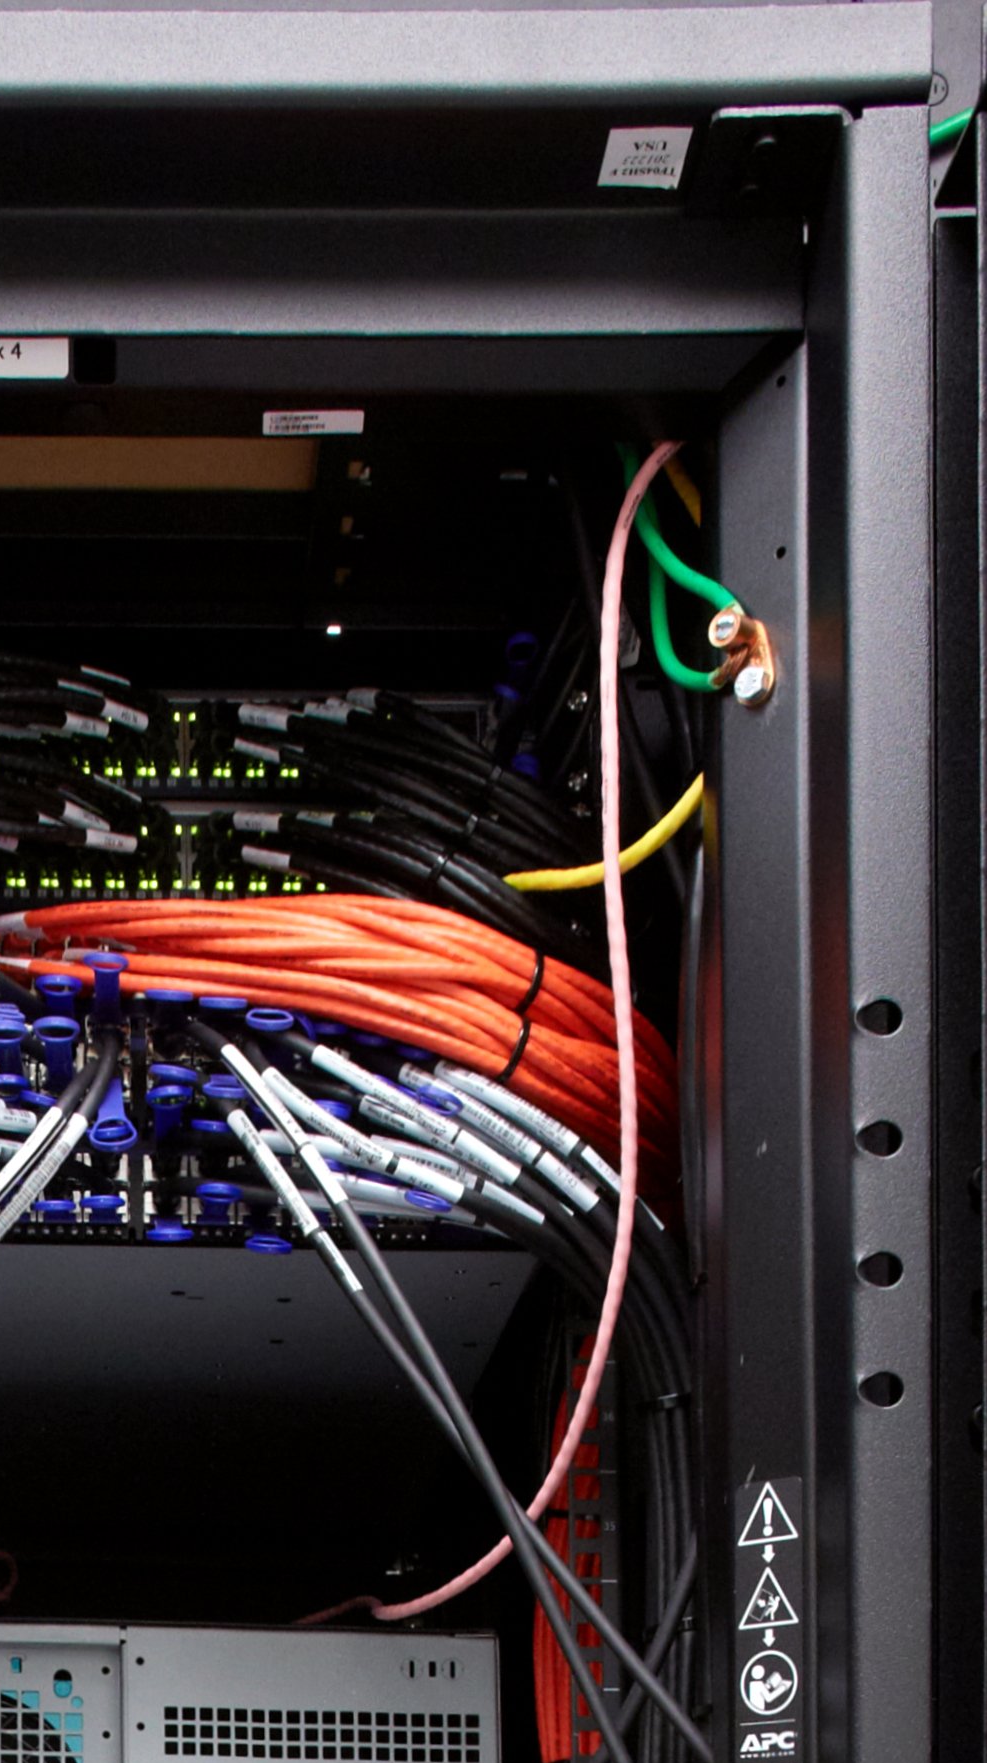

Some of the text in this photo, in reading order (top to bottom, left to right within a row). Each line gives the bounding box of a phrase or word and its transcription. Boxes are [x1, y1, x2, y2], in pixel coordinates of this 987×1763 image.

[633, 140, 667, 152] USA
[11, 343, 22, 359] 4
[740, 1731, 795, 1752] APC
